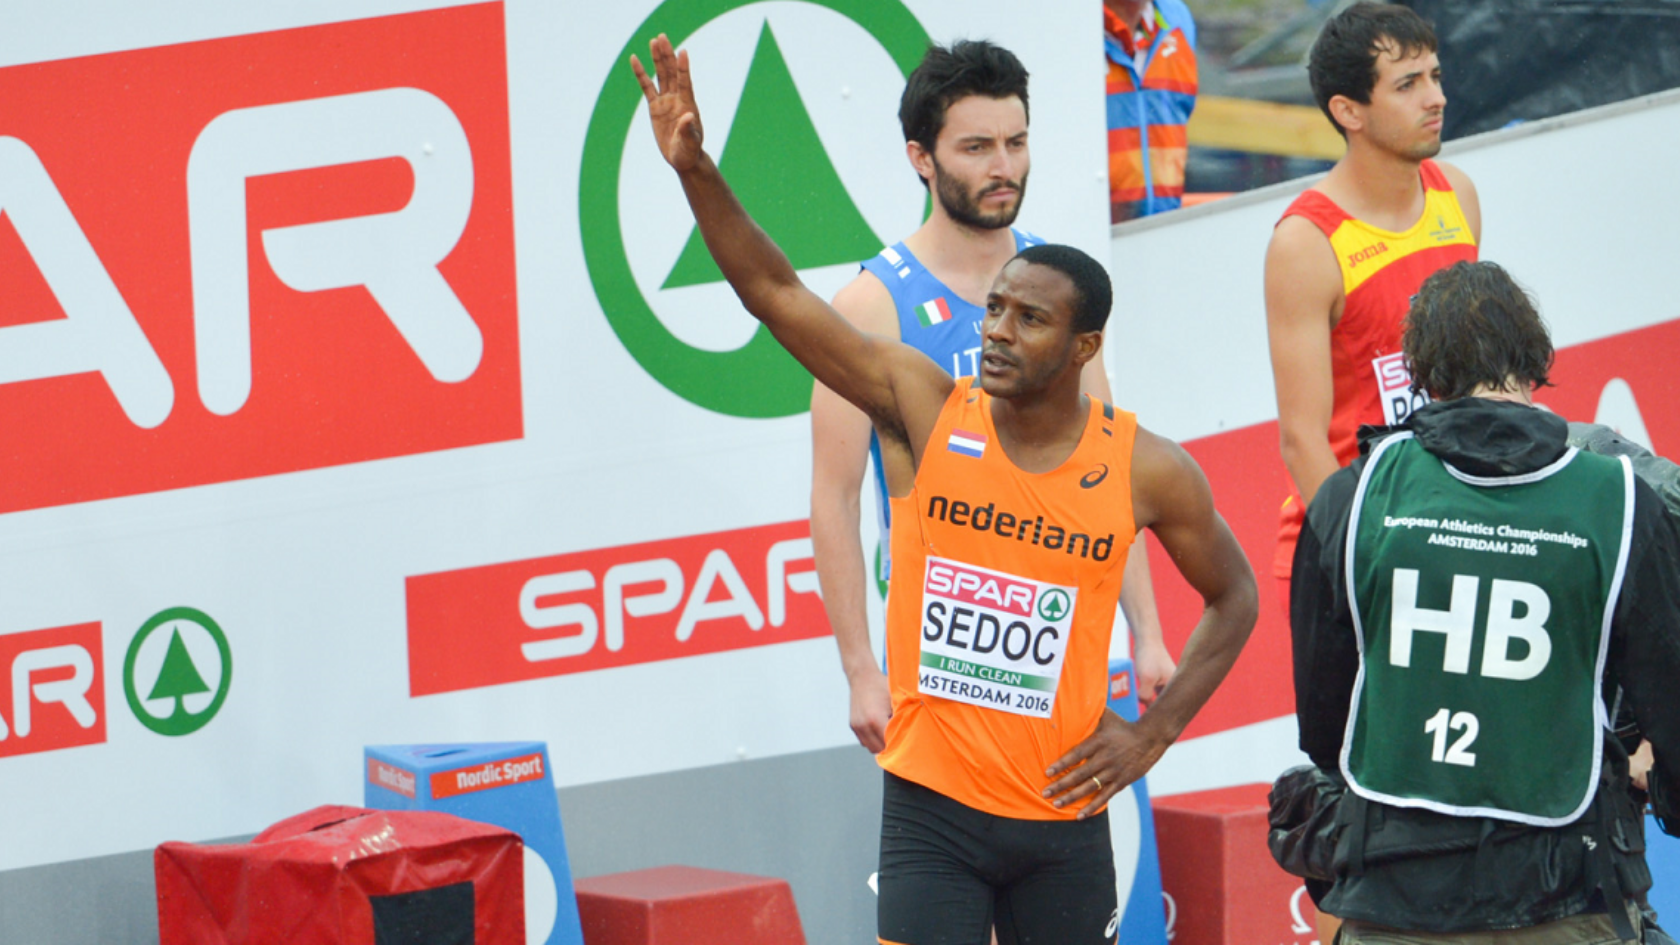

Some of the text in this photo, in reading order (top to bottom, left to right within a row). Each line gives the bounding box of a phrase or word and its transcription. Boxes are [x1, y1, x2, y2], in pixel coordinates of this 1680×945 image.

[927, 495, 1115, 562] nederland
[1384, 515, 1588, 548] European Athletics Championships
[1427, 532, 1538, 556] AMSTERDAM 2016
[928, 564, 1033, 613] SPAR
[923, 601, 1059, 665] SEDOC
[1389, 567, 1552, 681] HB
[918, 672, 1050, 712] MSTERDAM 2016
[939, 657, 1022, 685] I RUN CLEAN
[1423, 708, 1480, 767] 12
[502, 756, 542, 782] Sport
